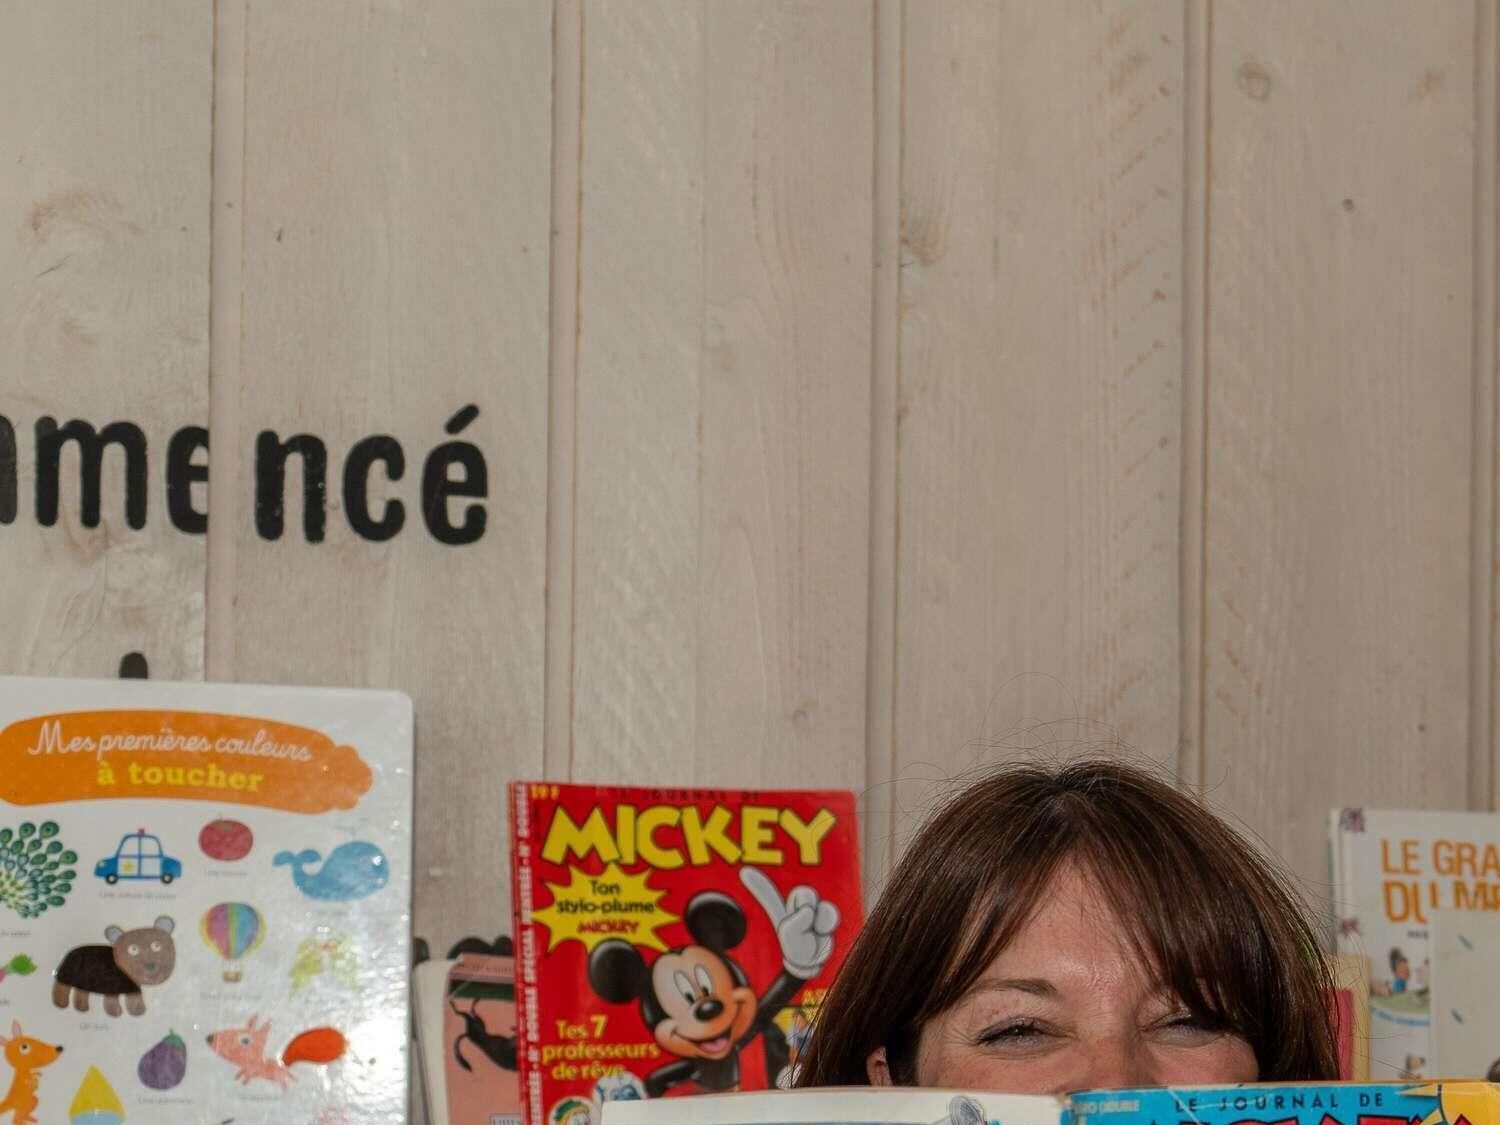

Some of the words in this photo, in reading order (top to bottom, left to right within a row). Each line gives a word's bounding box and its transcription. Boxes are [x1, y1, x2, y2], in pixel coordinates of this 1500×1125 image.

[28, 719, 96, 757] Mes
[97, 723, 212, 762] premières
[214, 726, 313, 762] couleurs
[97, 760, 116, 787] à
[129, 763, 264, 794] toucher
[541, 803, 837, 870] MICKEY
[1381, 839, 1421, 876] LE
[589, 879, 621, 896] Ton
[556, 899, 655, 917] stylo-plume
[1383, 880, 1440, 926] DU
[577, 919, 640, 936] MICKEY
[556, 1019, 588, 1039] Tes
[590, 1013, 608, 1039] 7
[542, 1043, 660, 1066] professeurs
[551, 1061, 578, 1080] de
[1175, 1097, 1199, 1113] LE
[1217, 1093, 1340, 1112] JOURNAL
[1359, 1092, 1385, 1108] DE
